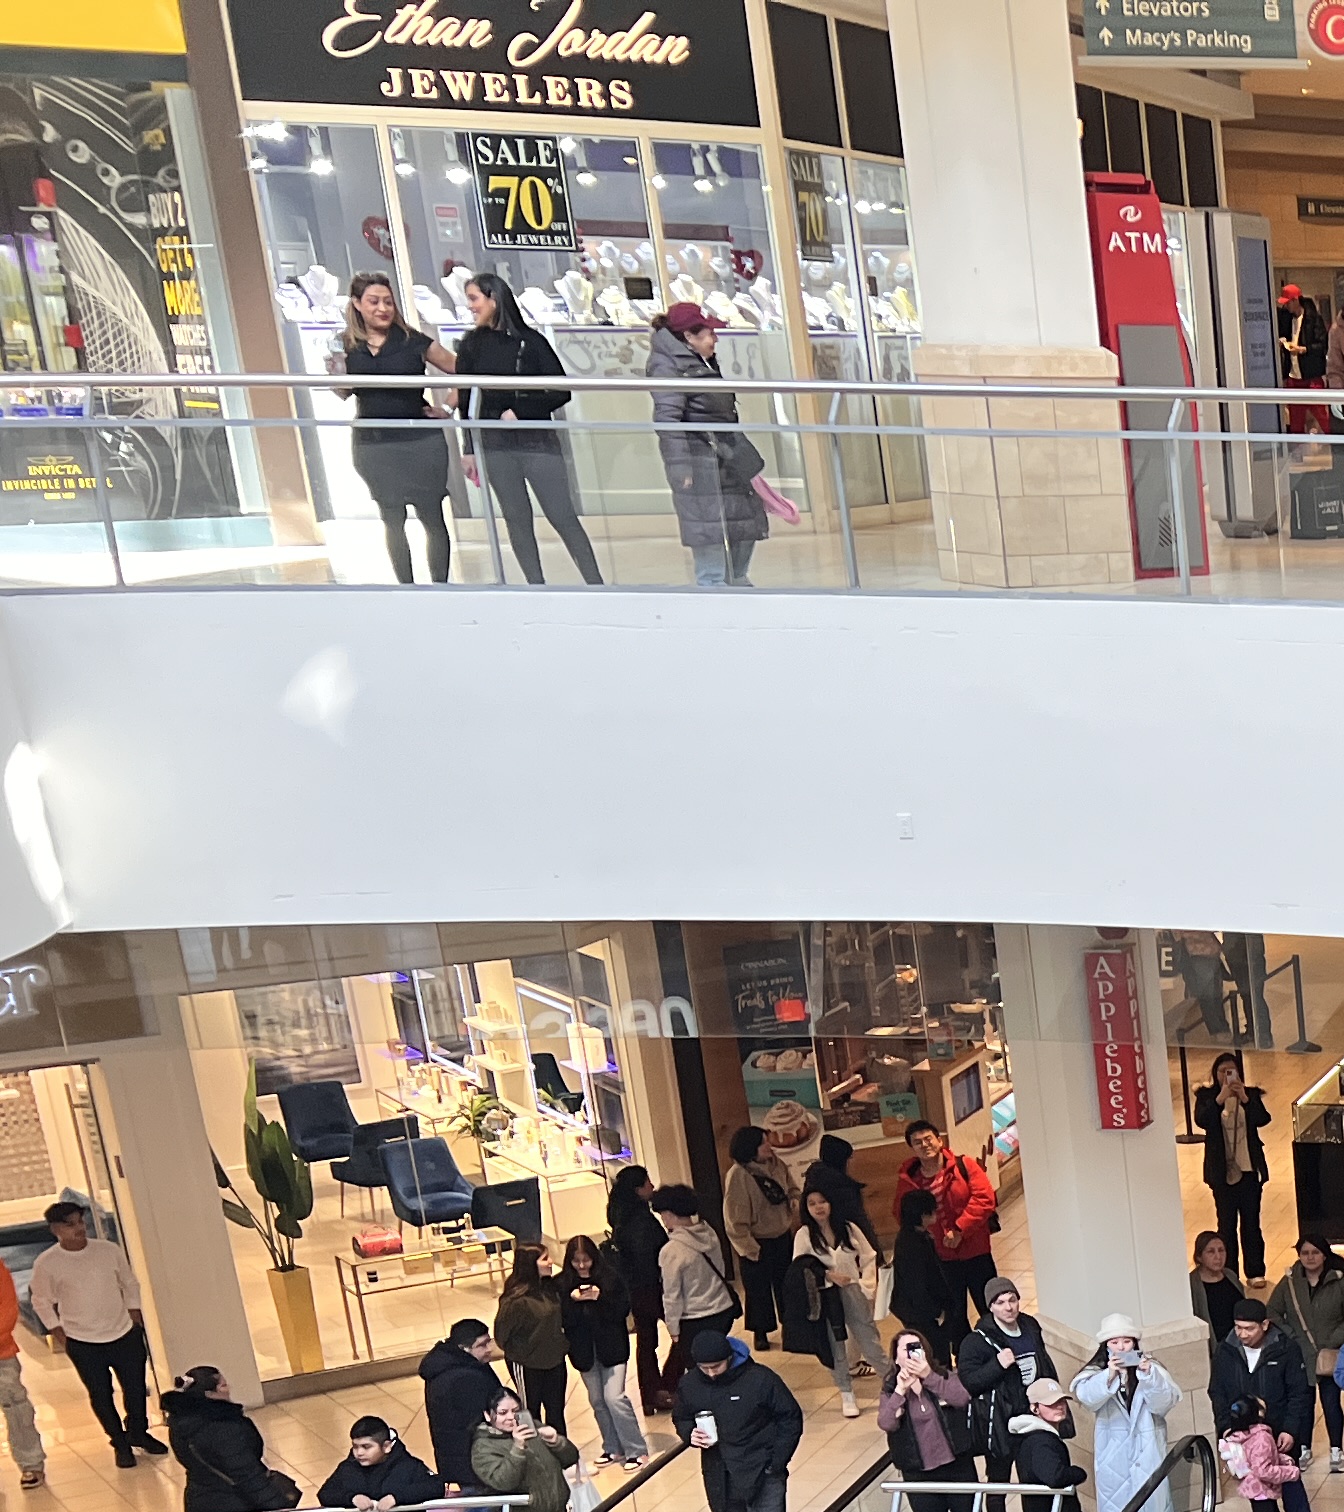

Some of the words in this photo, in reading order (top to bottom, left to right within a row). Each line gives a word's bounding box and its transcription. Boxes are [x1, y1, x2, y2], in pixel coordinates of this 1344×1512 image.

[1122, 0, 1210, 18] Elevators
[321, 0, 493, 58] Ethan
[506, 0, 690, 67] Jordan
[1124, 28, 1181, 50] Macy's
[1186, 29, 1251, 53] Parking
[380, 67, 635, 110] JEWELERS
[476, 137, 557, 167] SALE
[148, 192, 177, 228] BUY
[156, 235, 183, 273] GET
[490, 233, 513, 244] ALL
[516, 234, 570, 246] JEWELRY
[1108, 231, 1162, 254] ATM
[162, 279, 202, 316] MORE
[169, 323, 207, 347] WATCHES
[2, 478, 60, 491] INVINCIBLE
[28, 464, 82, 476] INVICTA
[1093, 955, 1128, 1128] Applebee's
[1126, 952, 1149, 1123] Applebee's
